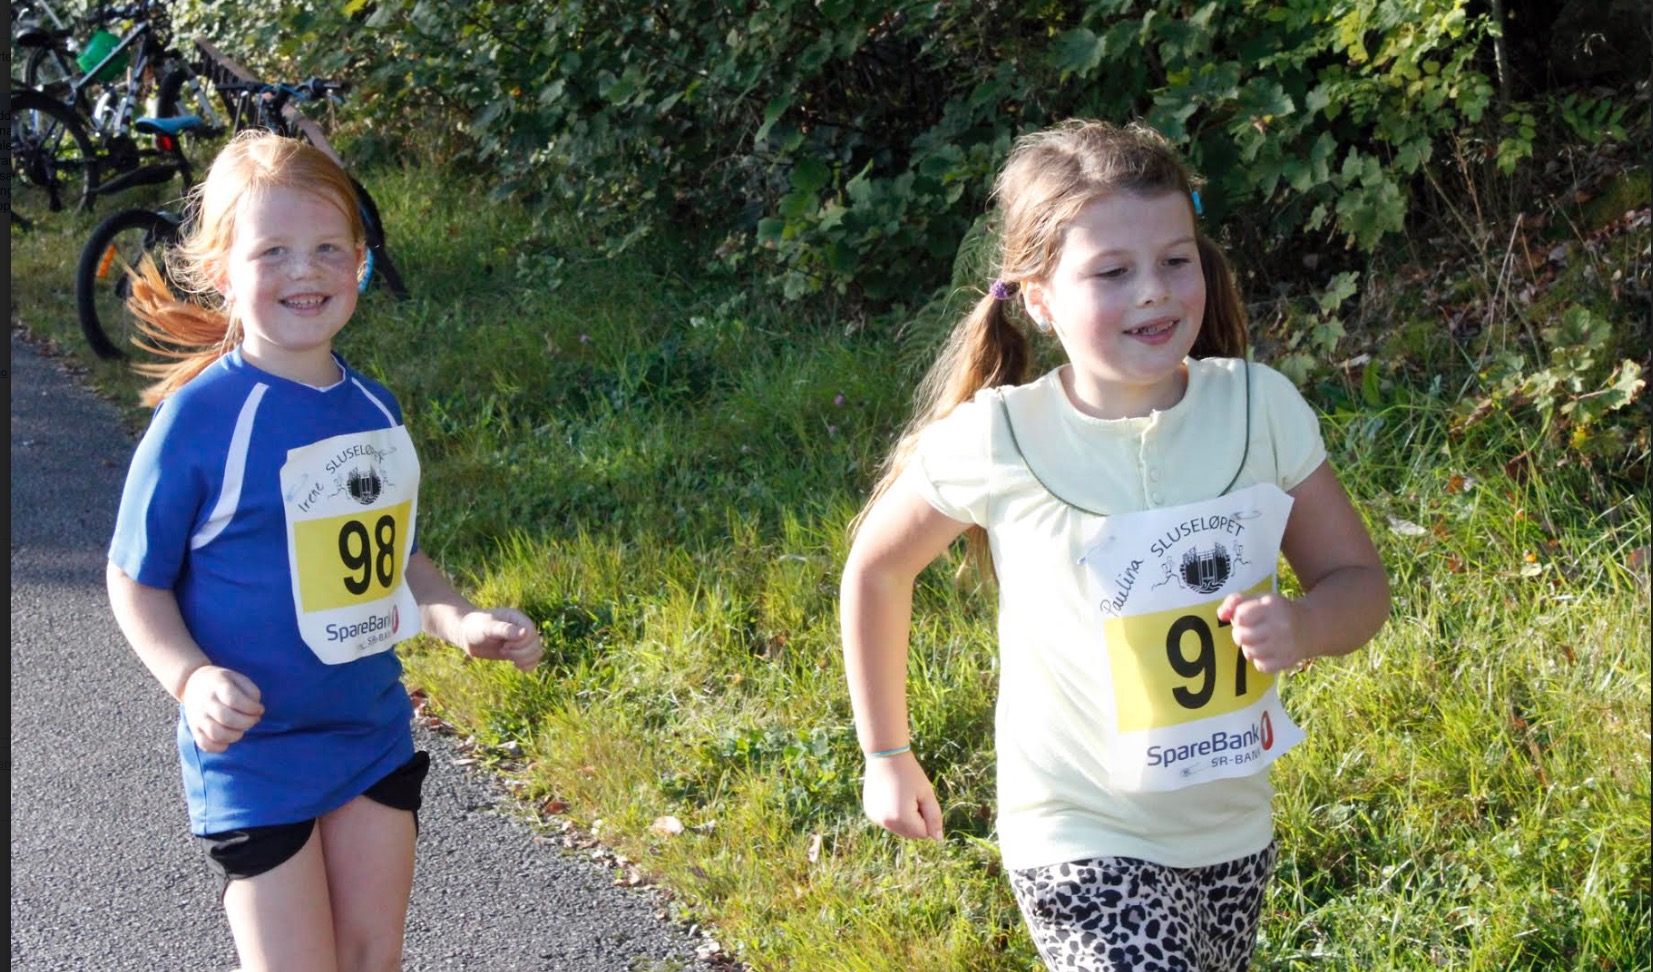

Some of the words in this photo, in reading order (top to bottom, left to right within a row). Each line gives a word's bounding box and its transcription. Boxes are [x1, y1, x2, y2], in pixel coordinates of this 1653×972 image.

[298, 482, 324, 512] Irene
[338, 515, 396, 595] 98
[1151, 515, 1245, 557] SLUSELØPET
[1101, 559, 1144, 617] Paulina
[1147, 723, 1259, 767] SpareBank
